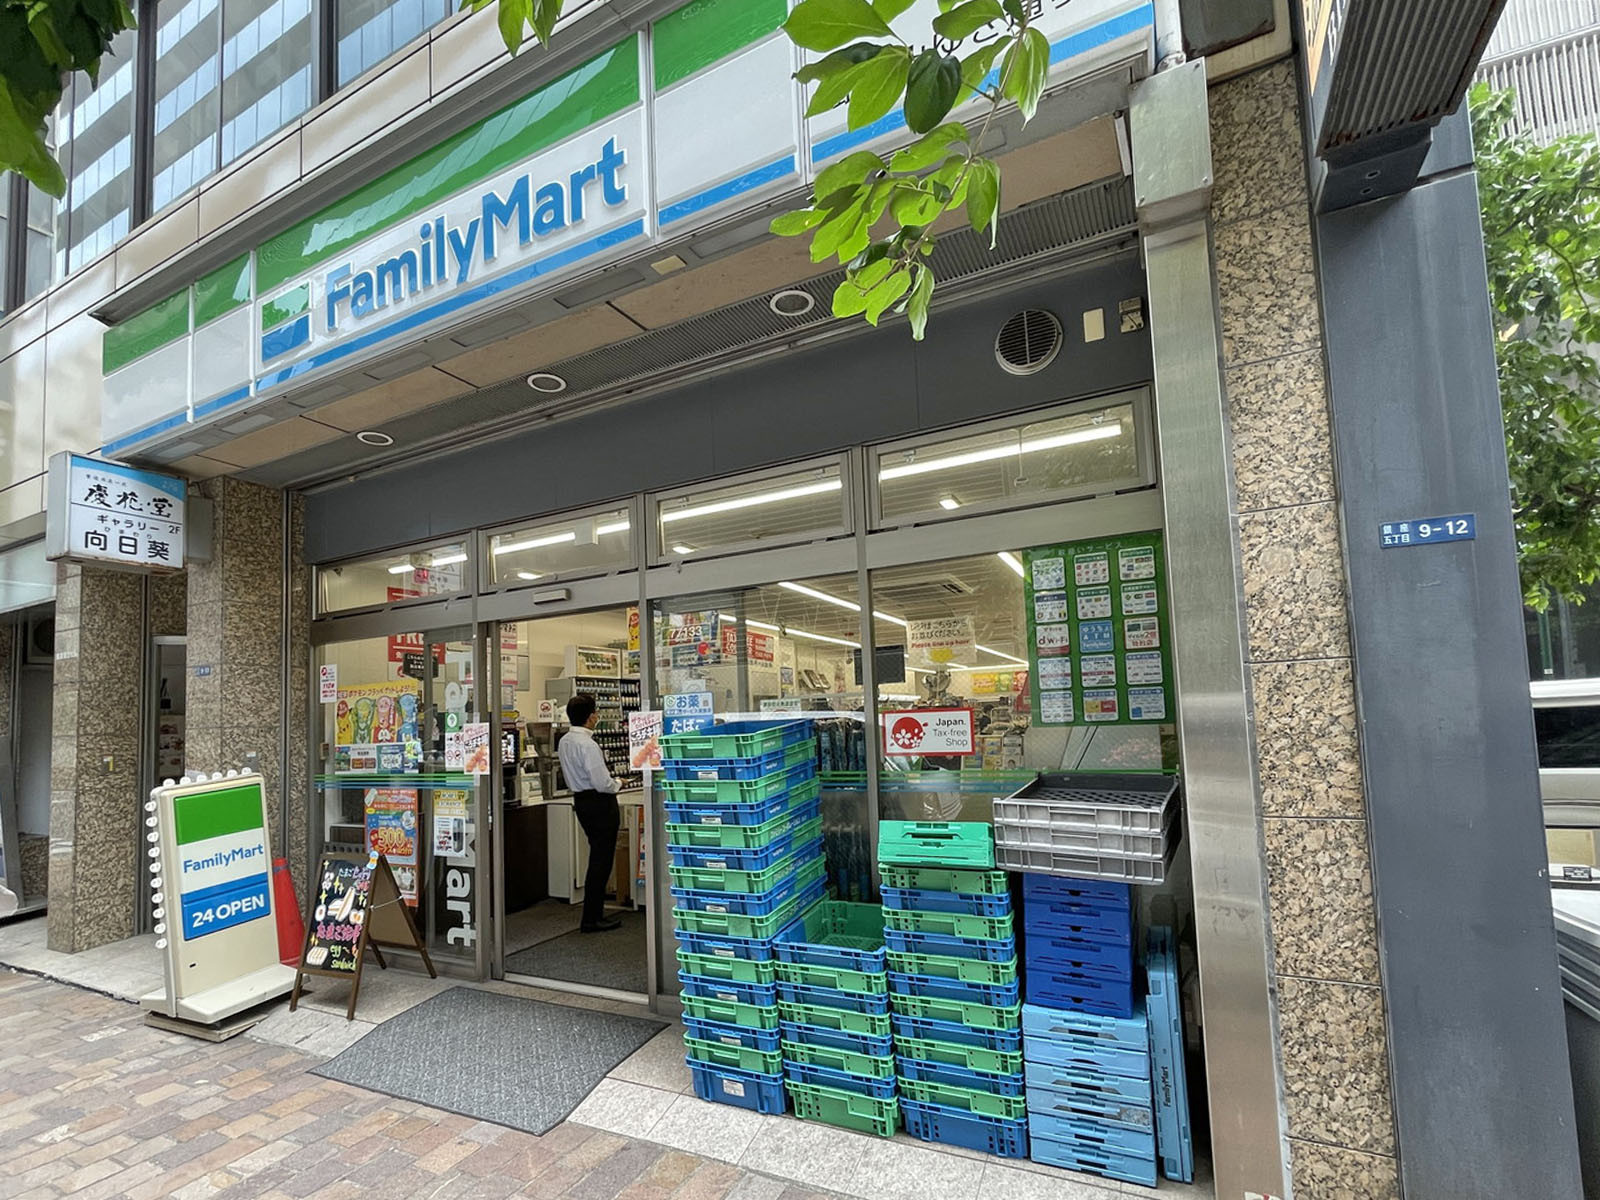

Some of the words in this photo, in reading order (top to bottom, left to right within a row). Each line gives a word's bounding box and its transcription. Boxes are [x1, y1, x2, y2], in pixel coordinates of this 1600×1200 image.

[326, 135, 628, 332] FamilyMart
[97, 514, 159, 531] ギャラリー
[168, 525, 181, 534] 2F
[1383, 523, 1409, 534] 銀座
[1419, 520, 1469, 538] 9-12
[84, 530, 170, 561] 向日葵
[1383, 533, 1410, 544] 五丁目
[677, 694, 700, 708] お薬
[671, 719, 705, 733] たばこ
[933, 728, 967, 737] Tax-free
[945, 737, 968, 747] Shop
[184, 844, 264, 874] FamilyMart
[192, 909, 216, 929] 24
[215, 894, 265, 920] OPEN
[1161, 1066, 1171, 1107] FamilyMart
